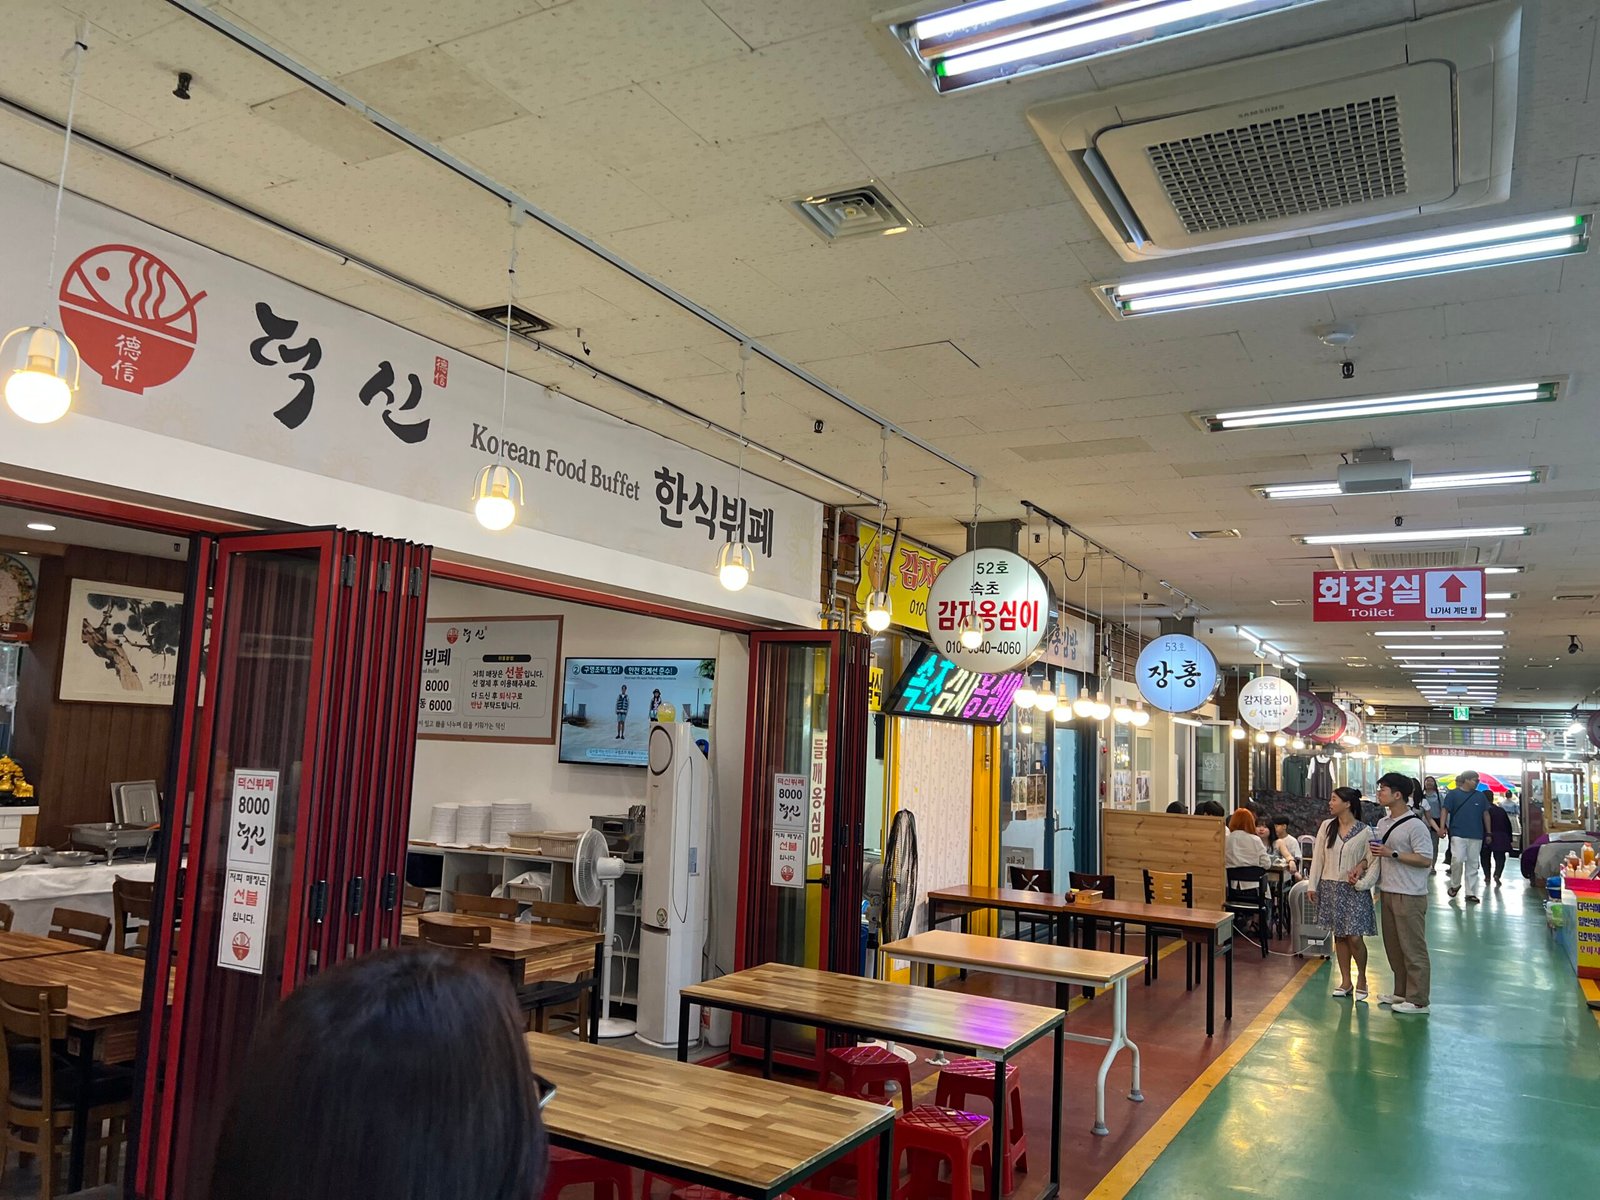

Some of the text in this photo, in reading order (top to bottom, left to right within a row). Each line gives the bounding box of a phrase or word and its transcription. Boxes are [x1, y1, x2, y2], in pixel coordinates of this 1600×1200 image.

[470, 423, 640, 501] Korean Food Buffet
[654, 466, 774, 558] 한식뷔페
[976, 561, 1009, 575] 52호
[970, 581, 1000, 596] 속초
[1318, 575, 1421, 606] 화장실
[938, 600, 1039, 632] 감자옹심이
[1348, 608, 1395, 617] Toilet
[1165, 642, 1187, 651] 53호
[472, 670, 484, 678] 저희
[486, 670, 503, 678] 매장은
[425, 680, 449, 691] 8000
[429, 700, 452, 711] 6000
[484, 701, 520, 710] 부탁드립니다.
[1244, 695, 1292, 705] 감자옹심이
[238, 777, 274, 791] 덕신뷔페
[777, 778, 804, 786] 덕신뷔페
[778, 789, 803, 800] 8000
[810, 738, 824, 858] 들깨옹심이
[239, 796, 270, 815] 8000
[230, 873, 266, 886] 저희 매장은
[234, 889, 258, 907] 선불
